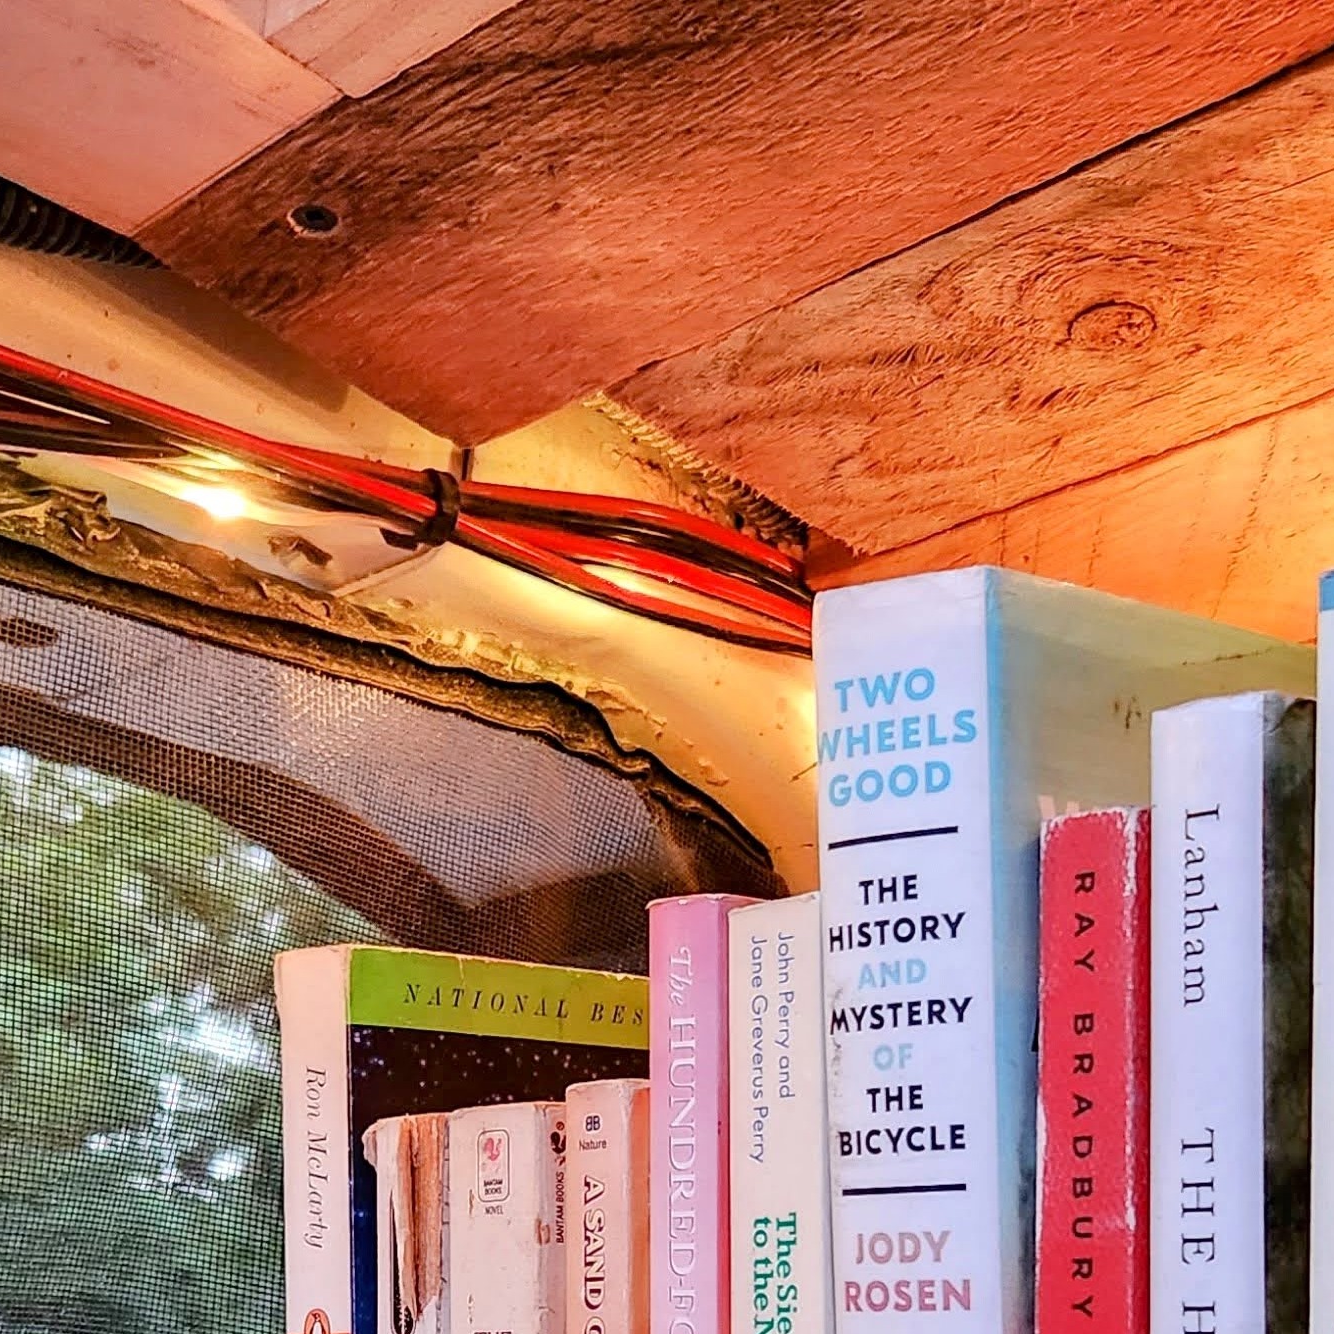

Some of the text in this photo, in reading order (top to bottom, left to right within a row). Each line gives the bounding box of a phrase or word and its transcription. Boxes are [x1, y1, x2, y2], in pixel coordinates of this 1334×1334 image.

[834, 667, 935, 713] TWO
[817, 708, 978, 766] WHEELS
[828, 760, 952, 808] GOOD
[858, 874, 919, 906] THE
[1183, 803, 1220, 1008] Lanham
[829, 911, 966, 953] HISTORY
[668, 946, 694, 1007] The
[857, 958, 927, 991] AND
[404, 983, 570, 1019] NATIONAL
[775, 932, 796, 1099] John Perry and
[829, 997, 973, 1036] MYSTERY
[749, 935, 770, 1164] Jane Greverus Perry
[872, 1043, 915, 1070] OF
[866, 1085, 924, 1114] THE
[1071, 871, 1096, 1319] RAY BRADBURY
[304, 1065, 329, 1249] Ron McLarty
[579, 1139, 607, 1151] Nature
[838, 1124, 967, 1157] BICYCLE
[484, 1205, 504, 1215] NOVEL
[555, 1172, 565, 1243] BANTAM BOOKS
[584, 1175, 605, 1206] A
[1180, 1127, 1216, 1265] THE
[753, 1216, 772, 1248] to
[776, 1212, 798, 1279] The
[855, 1230, 952, 1265] JODY
[584, 1209, 605, 1310] SAND
[753, 1253, 774, 1311] the
[843, 1278, 972, 1314] ROSEN
